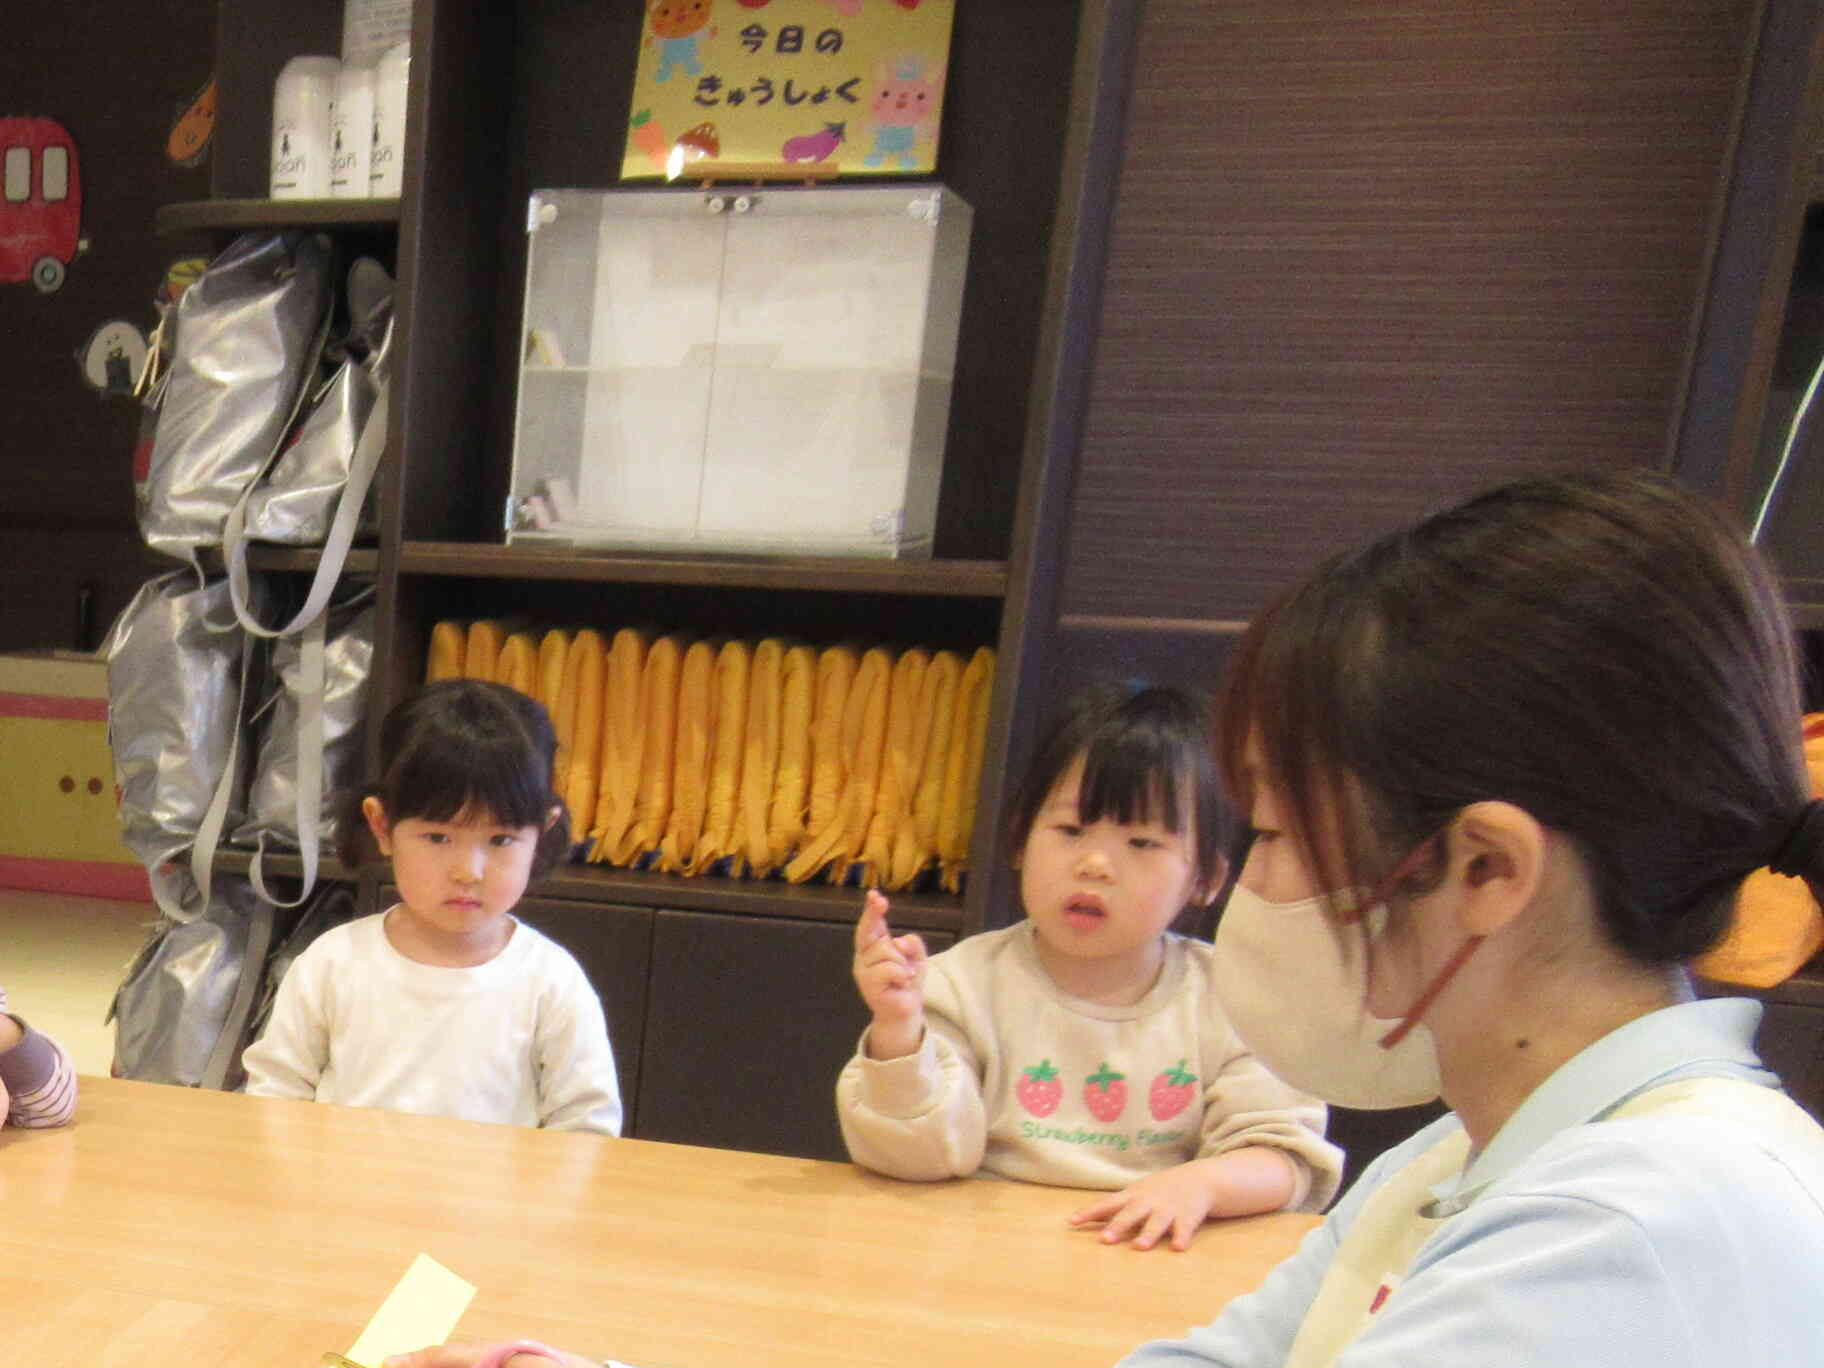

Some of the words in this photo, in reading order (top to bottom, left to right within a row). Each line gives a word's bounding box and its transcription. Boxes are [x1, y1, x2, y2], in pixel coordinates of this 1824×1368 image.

[740, 23, 844, 54] 今日の
[692, 74, 862, 106] きゅうしょく
